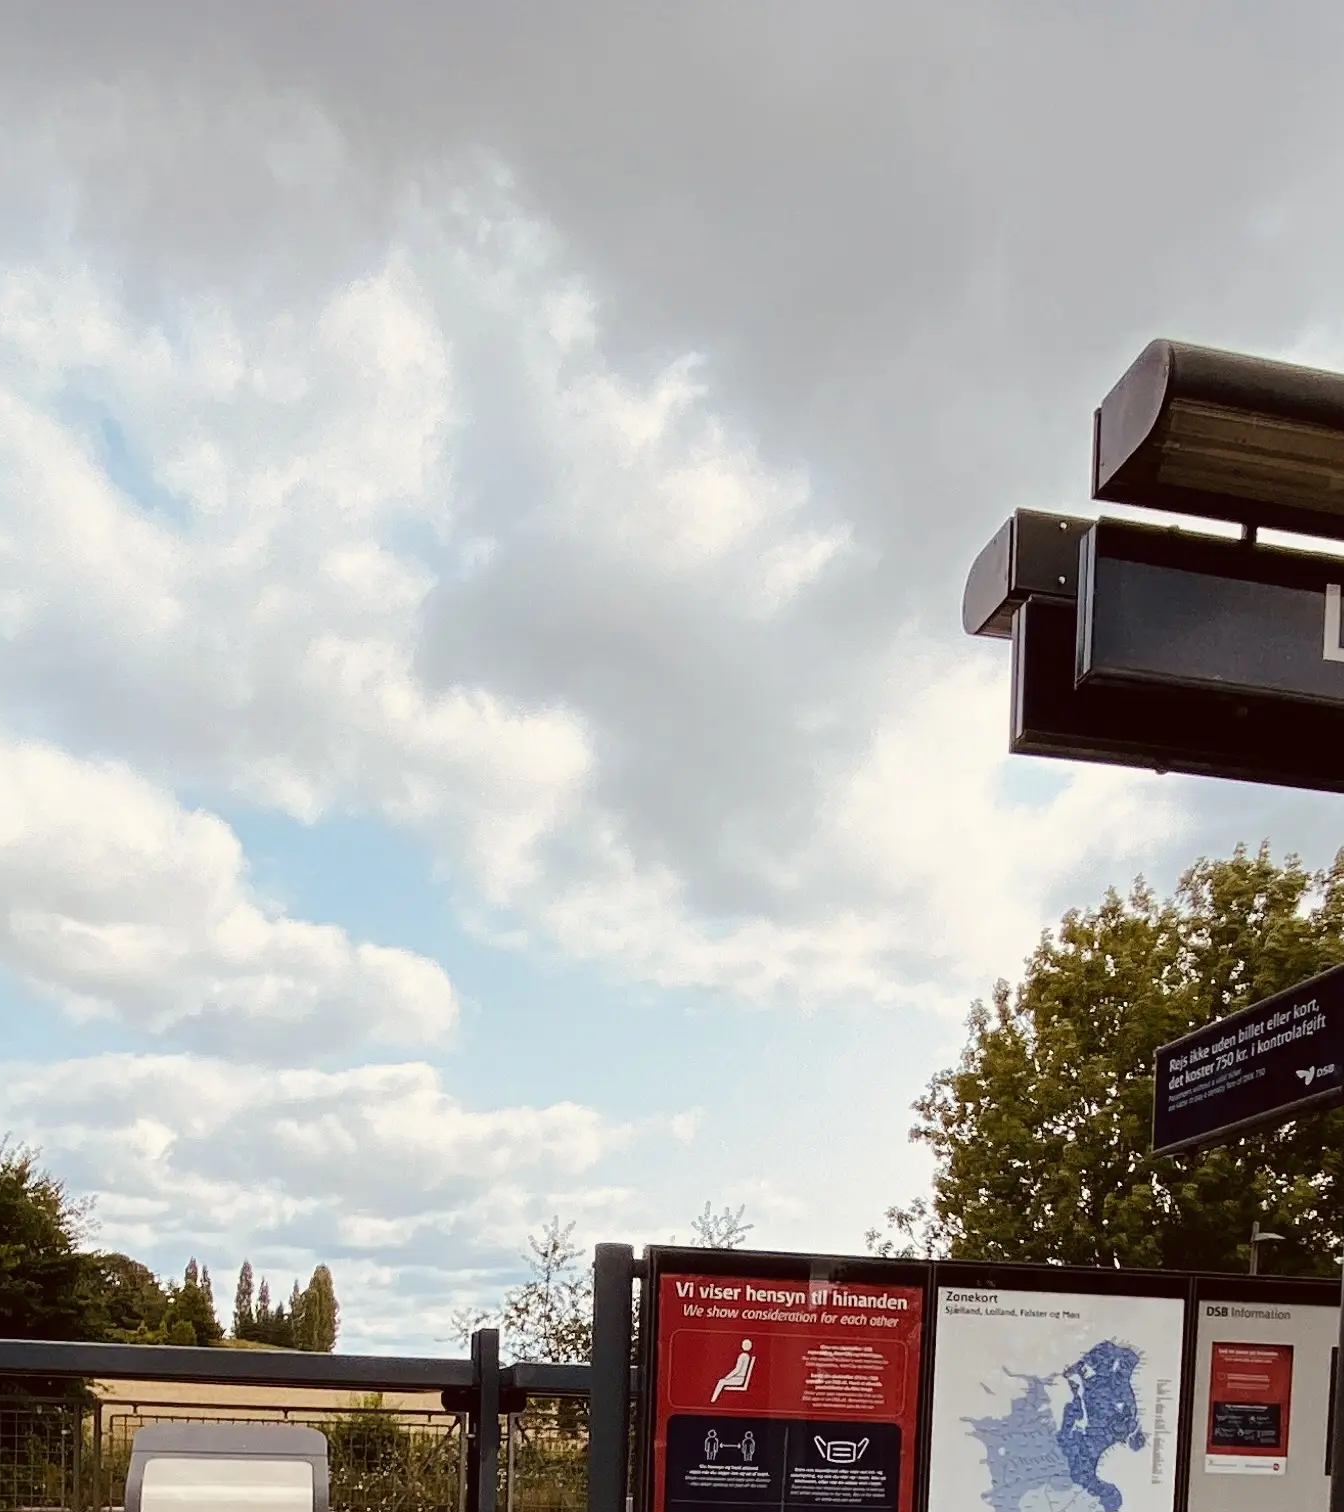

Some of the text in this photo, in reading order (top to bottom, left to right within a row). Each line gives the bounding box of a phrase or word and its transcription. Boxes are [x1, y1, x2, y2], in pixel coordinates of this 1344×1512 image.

[1169, 999, 1320, 1073] Rejs ikke uden billet eller kort,
[1168, 1075, 1184, 1090] det
[1185, 1062, 1214, 1083] koster
[1215, 1051, 1233, 1072] 750
[1236, 1049, 1249, 1063] kr.
[1257, 1013, 1327, 1054] kontrolafgift
[1316, 1064, 1335, 1077] DSB
[675, 1281, 907, 1310] Vi viser hensyn til hinanden
[946, 1291, 998, 1303] Zonekort
[683, 1304, 899, 1328] We show consideration for each other
[1206, 1306, 1291, 1320] DSB Information
